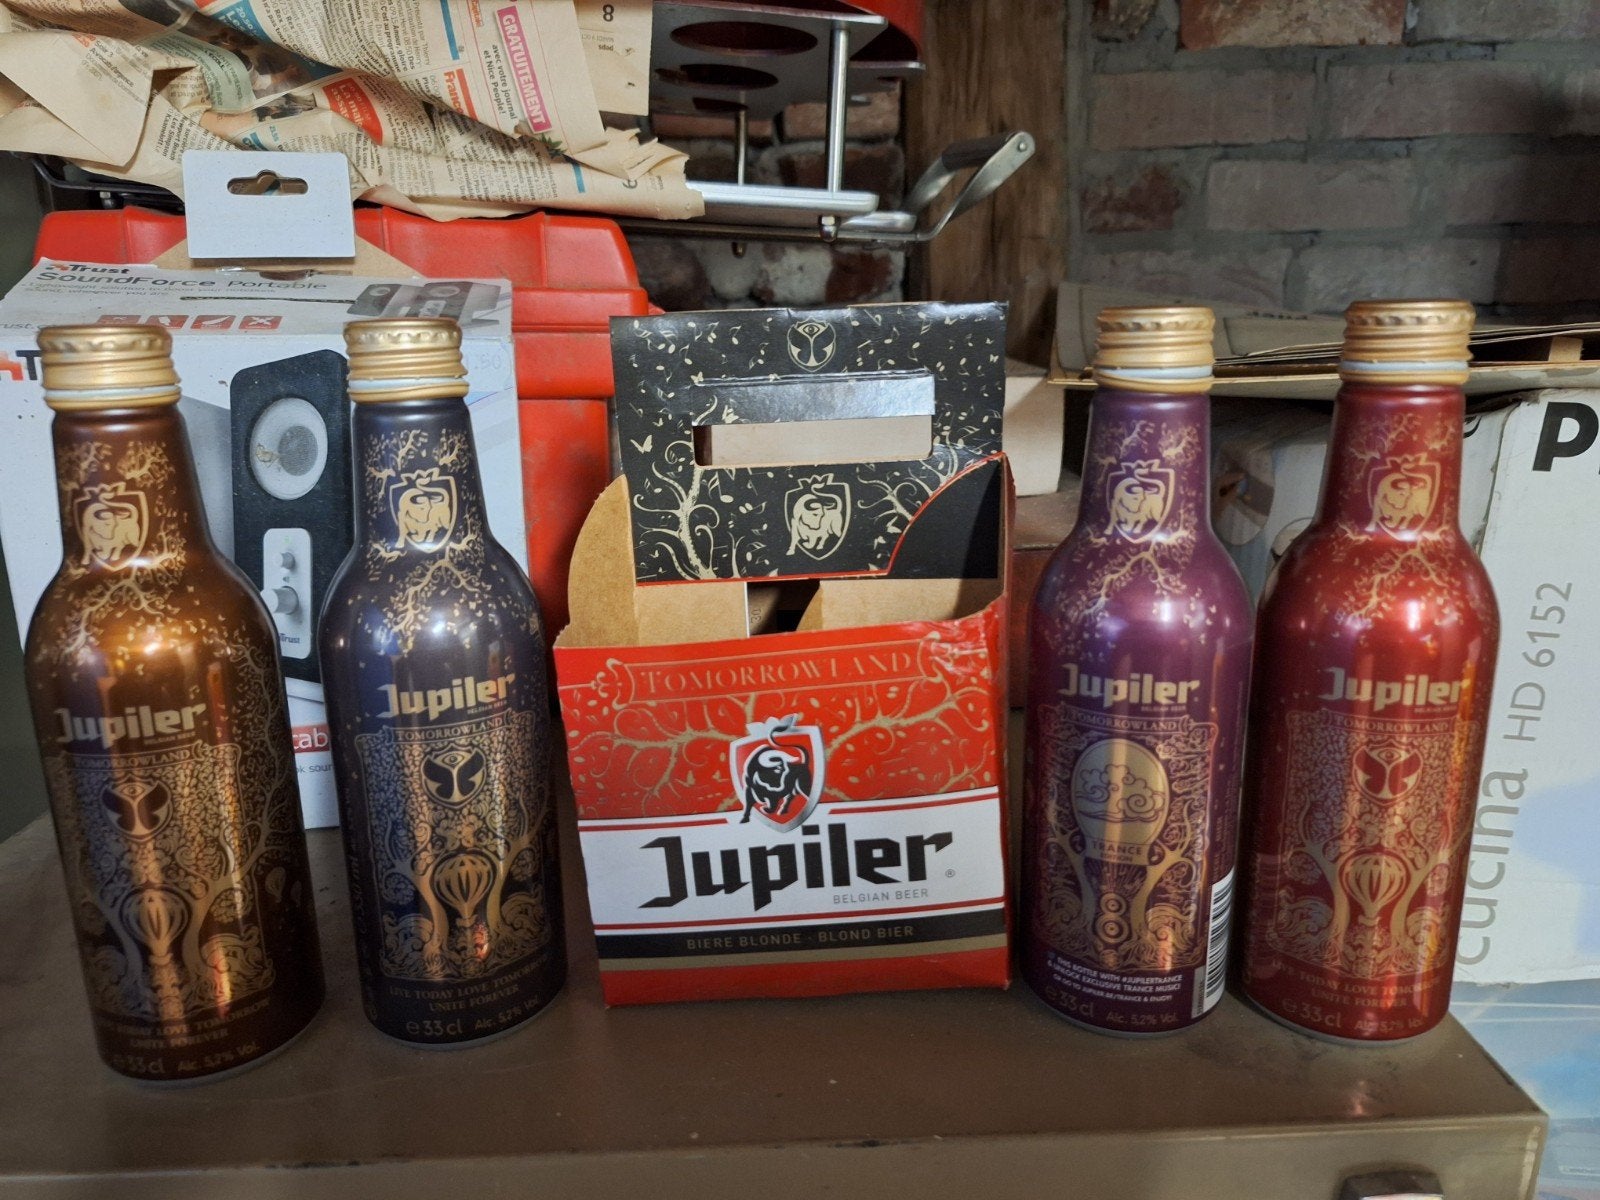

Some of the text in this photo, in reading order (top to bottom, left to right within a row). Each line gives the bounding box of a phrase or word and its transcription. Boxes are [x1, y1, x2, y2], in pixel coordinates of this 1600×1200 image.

[603, 4, 615, 22] 8
[396, 49, 408, 71] gloire
[407, 55, 415, 69] Des
[501, 13, 545, 125] GRATUITEMENT
[339, 83, 351, 99] La
[482, 49, 506, 115] et Nice People!
[491, 43, 518, 120] avec votre journal
[160, 117, 178, 157] Les Simpson
[169, 141, 179, 160] Beach
[70, 264, 130, 274] Trust
[36, 271, 327, 290] SoundForce Portable
[640, 651, 912, 694] TOMORROWLAND
[1058, 662, 1200, 709] Jupiler
[1318, 666, 1472, 712] Jupiler
[376, 673, 516, 721] Jupiler
[53, 703, 207, 749] Jupiler
[395, 718, 503, 741] TOMORROWLAND
[1067, 711, 1177, 731] TOMORROWLAND
[1334, 714, 1449, 733] TOMORROWLAND
[1456, 581, 1573, 967] cucina HD 6152
[1092, 840, 1142, 855] TRANCE
[637, 822, 954, 912] Jupiler
[833, 887, 930, 905] BELGIAN BEER
[686, 924, 915, 950] BIERE BLONDE BLOND BIER
[1054, 962, 1081, 981] UNLOCK
[1082, 975, 1121, 990] EXCLUSIVE
[1123, 983, 1154, 993] TRANCE
[1155, 983, 1182, 993] MUSIC!
[1072, 962, 1098, 978] BOTTLE
[1100, 971, 1121, 982] WITH
[457, 982, 488, 996] LOVE
[1344, 984, 1377, 996] LOVE
